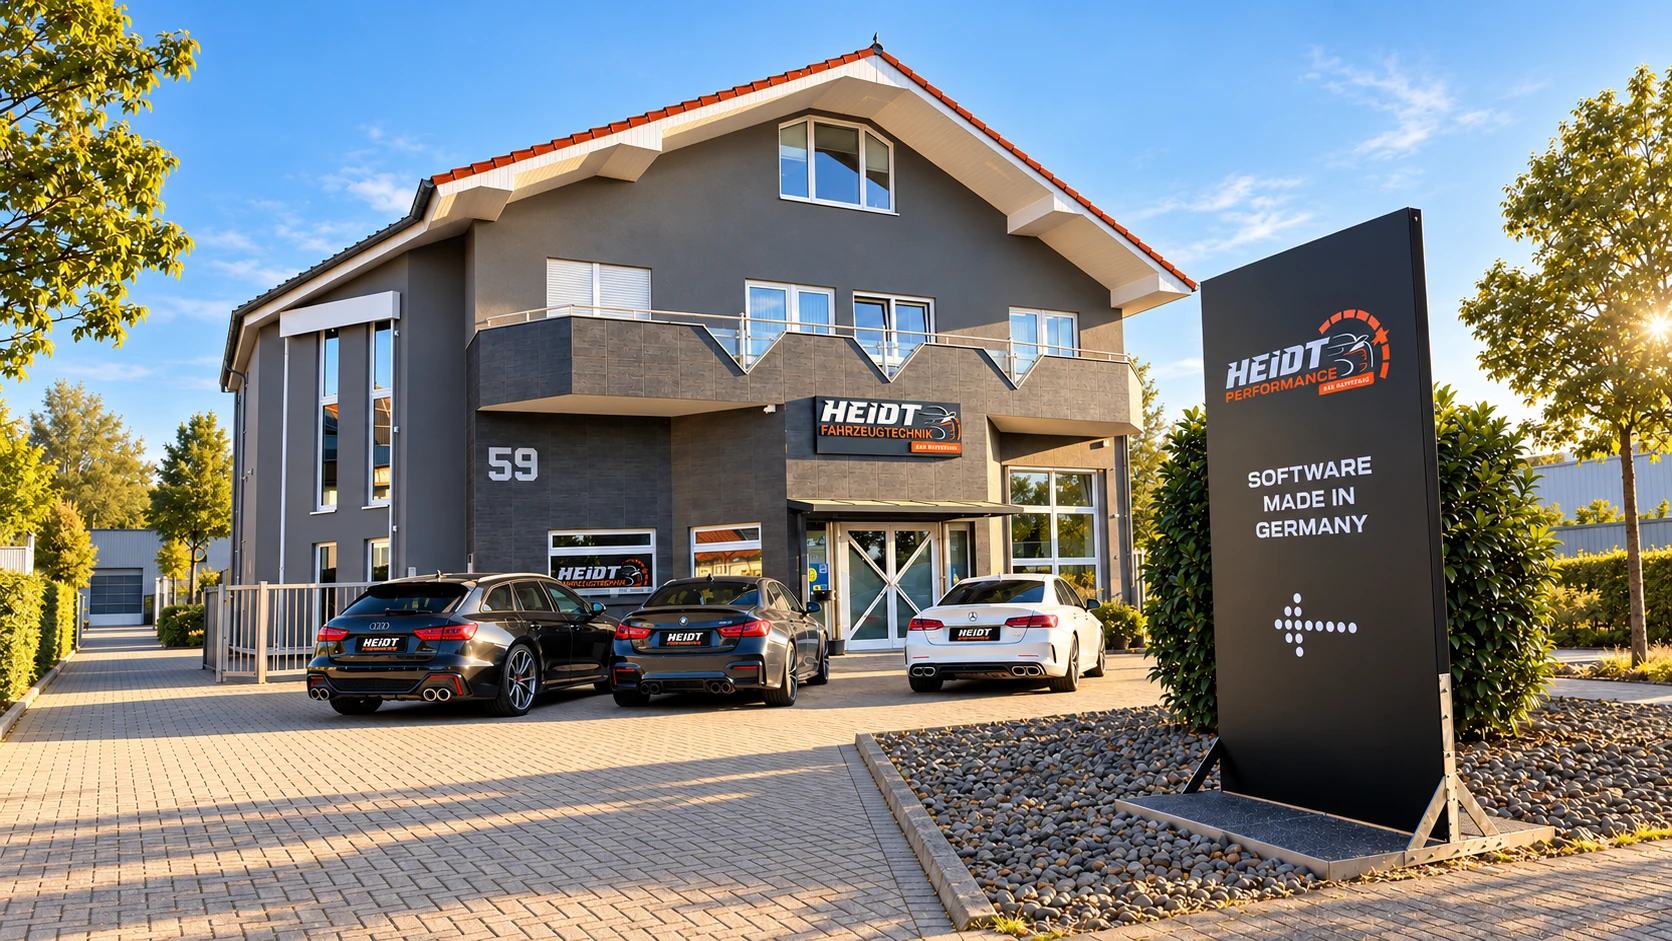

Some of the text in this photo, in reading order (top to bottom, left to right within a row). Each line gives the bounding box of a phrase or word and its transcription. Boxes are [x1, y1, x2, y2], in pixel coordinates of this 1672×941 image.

[1225, 367, 1337, 403] PERFORMANCE
[821, 425, 933, 439] FAHRZEUGTECHNIK
[488, 447, 538, 481] 59
[1248, 456, 1372, 488] SOFTWARE
[1263, 487, 1355, 512] MADE IN
[1256, 514, 1368, 538] GERMANY
